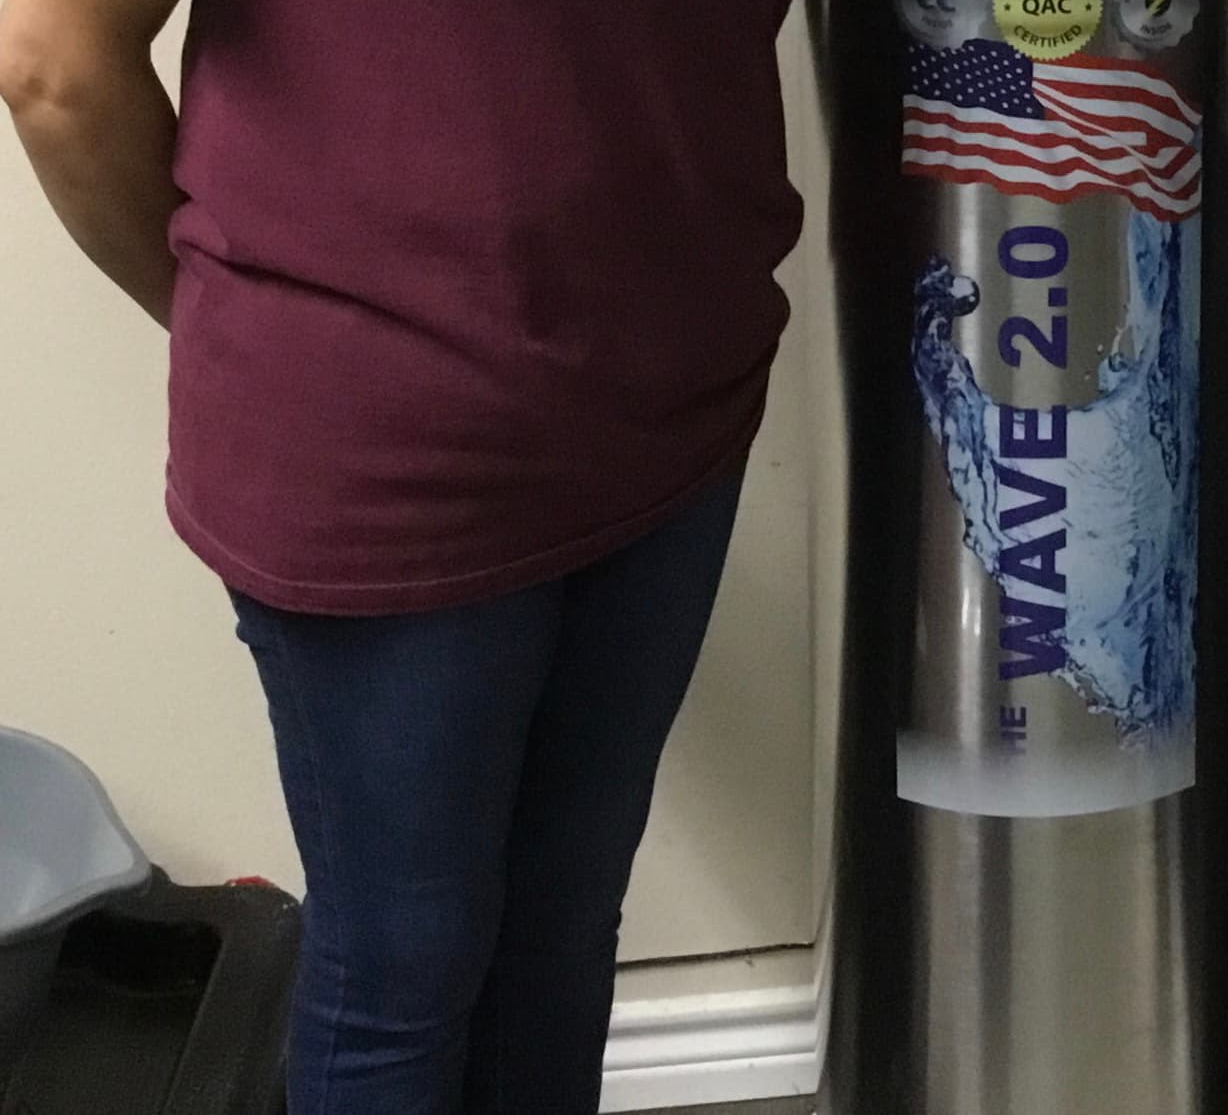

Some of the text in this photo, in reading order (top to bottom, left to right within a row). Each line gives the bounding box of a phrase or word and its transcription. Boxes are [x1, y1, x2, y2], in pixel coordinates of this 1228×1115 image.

[1014, 24, 1083, 48] CERTIFIED
[997, 224, 1069, 370] 2.0
[999, 404, 1069, 681] WAVE
